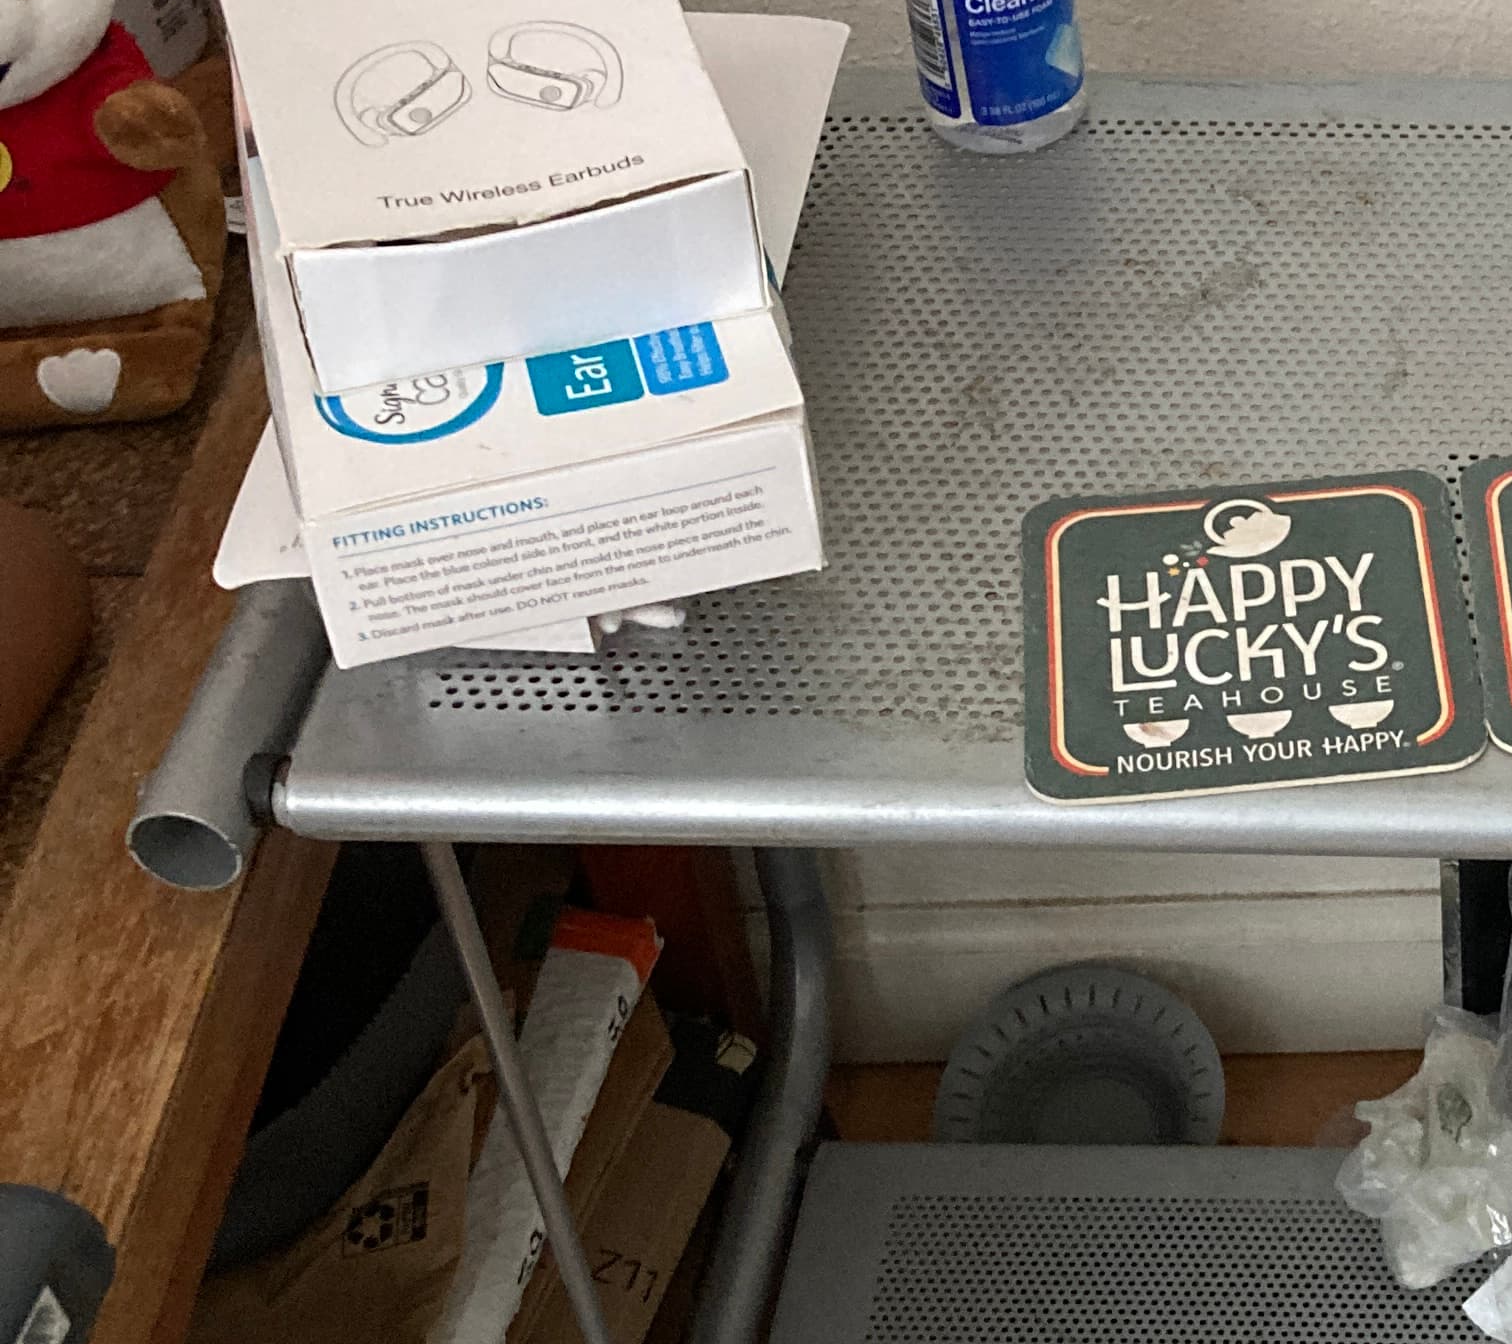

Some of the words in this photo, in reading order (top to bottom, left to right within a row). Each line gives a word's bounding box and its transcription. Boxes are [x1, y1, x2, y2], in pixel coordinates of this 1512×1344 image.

[377, 194, 433, 209] True
[440, 179, 542, 204] Wireless
[549, 154, 645, 188] Earbuds
[565, 354, 612, 401] Ear
[333, 524, 405, 548] FITTING
[409, 497, 549, 534] INSTRUCTIONS:
[355, 564, 388, 577] Place
[391, 558, 424, 571] mask
[428, 553, 454, 565] over
[457, 547, 487, 559] nose
[490, 539, 513, 553] and
[561, 523, 584, 538] and
[587, 519, 620, 537] place
[622, 514, 637, 525] an
[639, 510, 658, 522] ear
[661, 504, 688, 519] loop
[691, 494, 732, 511] around
[734, 485, 763, 500] each
[384, 574, 417, 587] Place
[420, 568, 440, 581] the
[443, 562, 470, 576] blue
[473, 554, 518, 570] colored
[521, 547, 545, 561] side
[548, 545, 560, 556] in
[598, 532, 621, 545] and
[623, 526, 642, 539] the
[645, 520, 678, 534] white
[681, 510, 725, 529] portion
[363, 596, 387, 609] Pull
[388, 587, 435, 605] bottom
[437, 584, 450, 596] of
[452, 577, 485, 592] mask
[488, 570, 524, 586] under
[527, 563, 553, 578] chin
[555, 559, 578, 572] and
[580, 552, 612, 566] mold
[614, 546, 634, 559] the
[636, 542, 665, 554] nose
[667, 534, 699, 551] piece
[701, 524, 743, 541] around
[745, 518, 765, 531] the
[405, 605, 428, 616] The
[430, 597, 465, 611] mask
[467, 589, 508, 604] should
[510, 582, 543, 596] cover
[546, 575, 571, 589] face
[573, 568, 602, 582] from
[605, 563, 625, 576] the
[627, 558, 656, 570] nose
[658, 554, 672, 564] to
[673, 538, 741, 560] underneath
[743, 532, 762, 545] the
[1096, 552, 1374, 632] HAPPY
[371, 623, 419, 640] Discard
[422, 615, 454, 629] mask
[458, 609, 487, 623] after
[516, 598, 538, 611] DO
[541, 591, 568, 605] NOT
[572, 585, 605, 599] reuse
[1110, 613, 1388, 692] LUCKY'S
[1112, 675, 1392, 717] TEAHOUSE
[1117, 746, 1232, 774] NOURISH
[1243, 739, 1312, 763] YOUR
